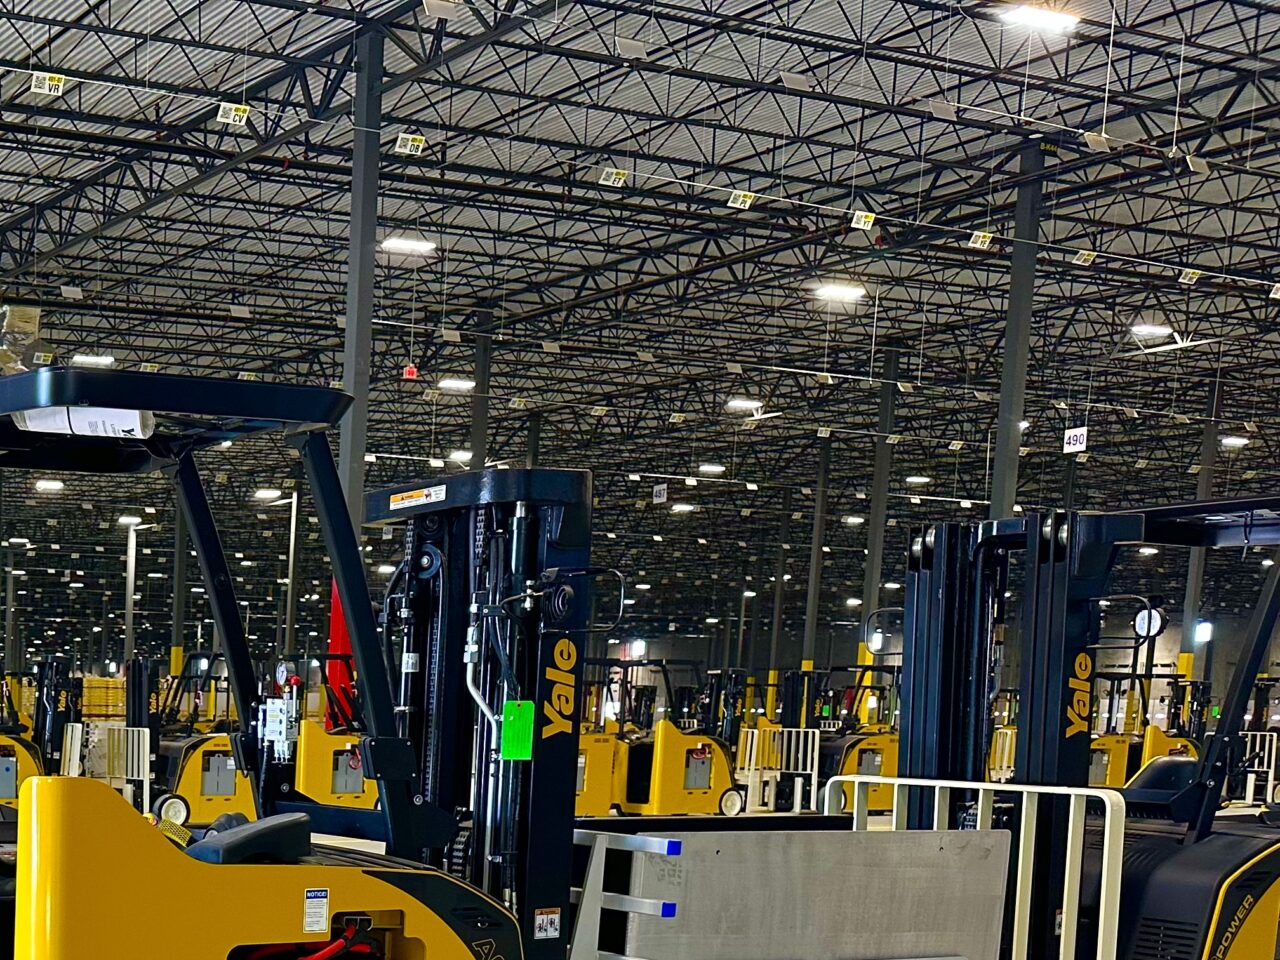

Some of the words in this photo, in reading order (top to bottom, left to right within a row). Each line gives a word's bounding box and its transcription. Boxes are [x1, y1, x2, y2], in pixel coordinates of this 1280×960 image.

[48, 83, 60, 94] VR
[232, 114, 244, 124] CV
[1065, 433, 1085, 446] 490
[542, 638, 577, 739] Yale
[1066, 652, 1092, 739] Yale
